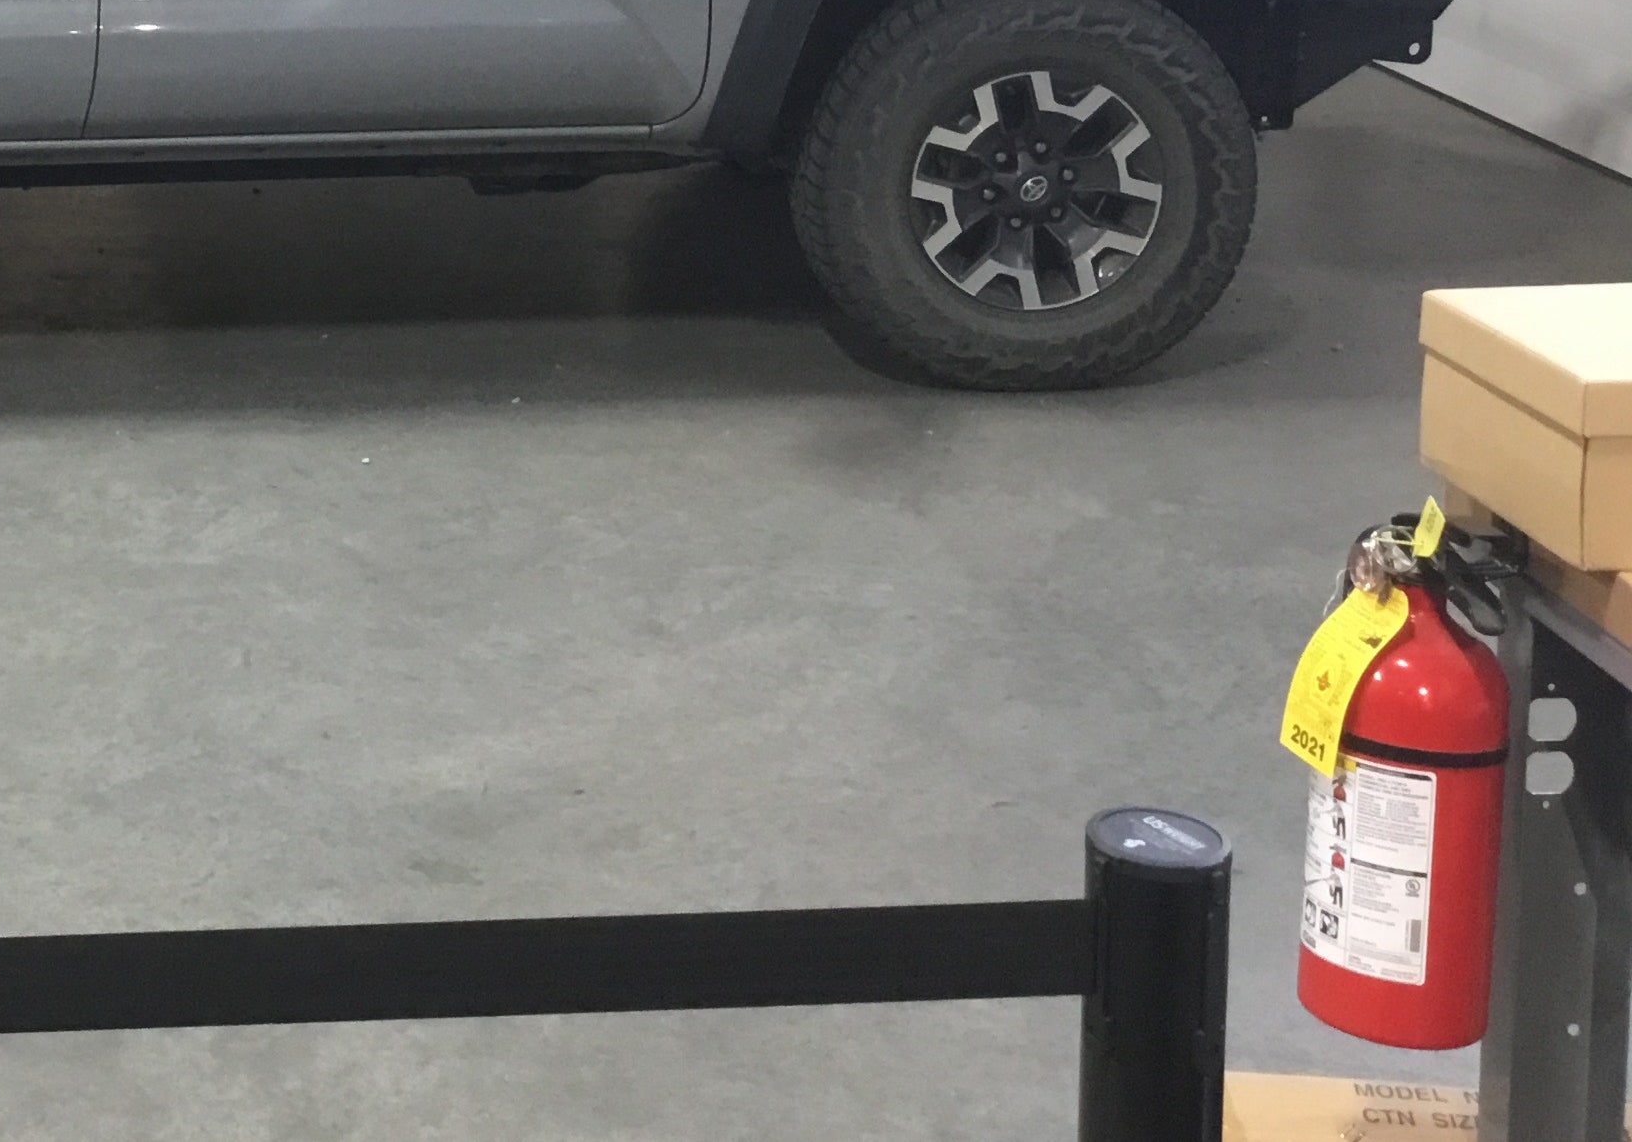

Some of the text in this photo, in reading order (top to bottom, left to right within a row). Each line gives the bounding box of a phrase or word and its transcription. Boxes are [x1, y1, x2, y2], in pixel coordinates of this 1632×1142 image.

[1291, 724, 1326, 762] 2021
[1353, 1083, 1449, 1104] MODEL
[1362, 1108, 1479, 1130] CTN SIZ
